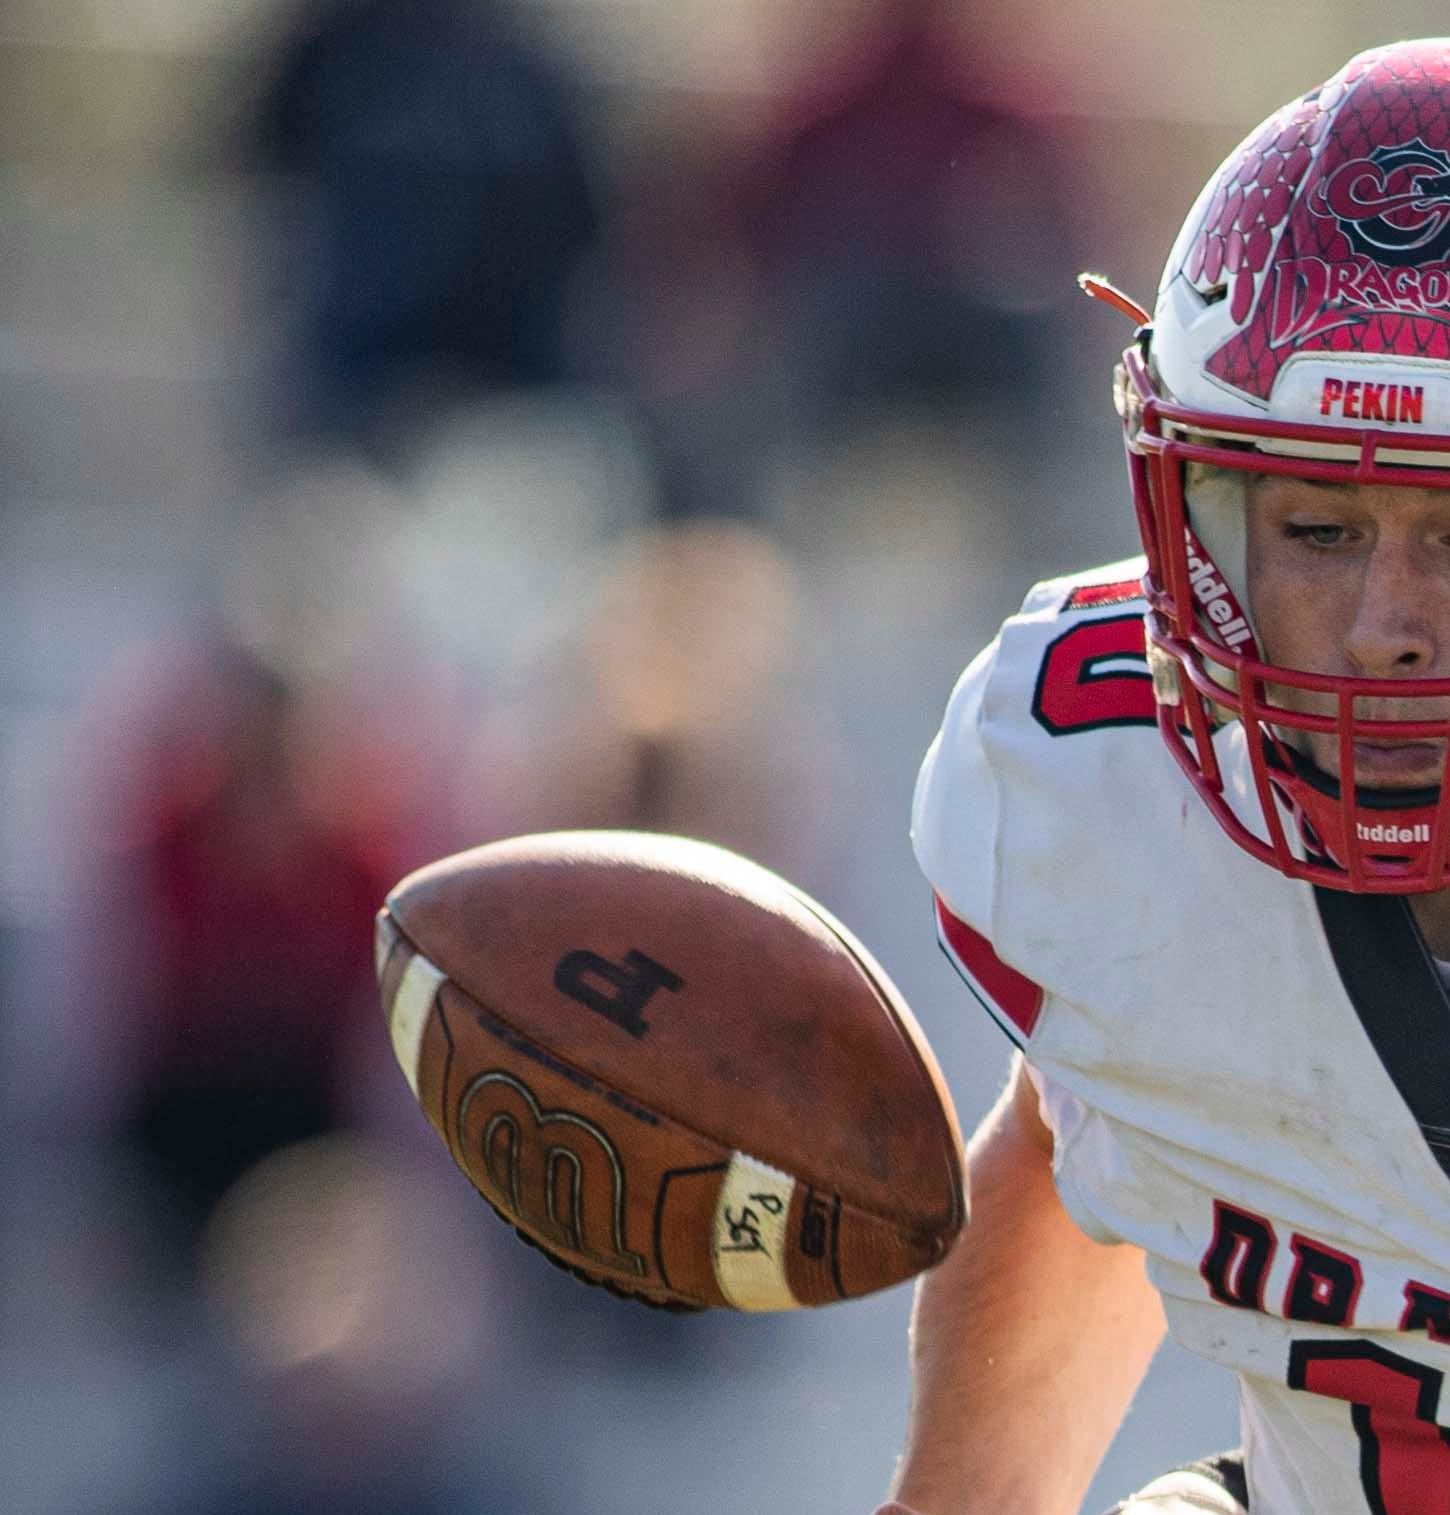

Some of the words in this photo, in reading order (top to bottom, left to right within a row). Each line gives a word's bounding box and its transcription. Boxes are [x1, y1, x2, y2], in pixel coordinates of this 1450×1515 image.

[1320, 377, 1424, 423] PEKIN
[1184, 527, 1251, 646] ddell
[1356, 822, 1430, 843] iddell
